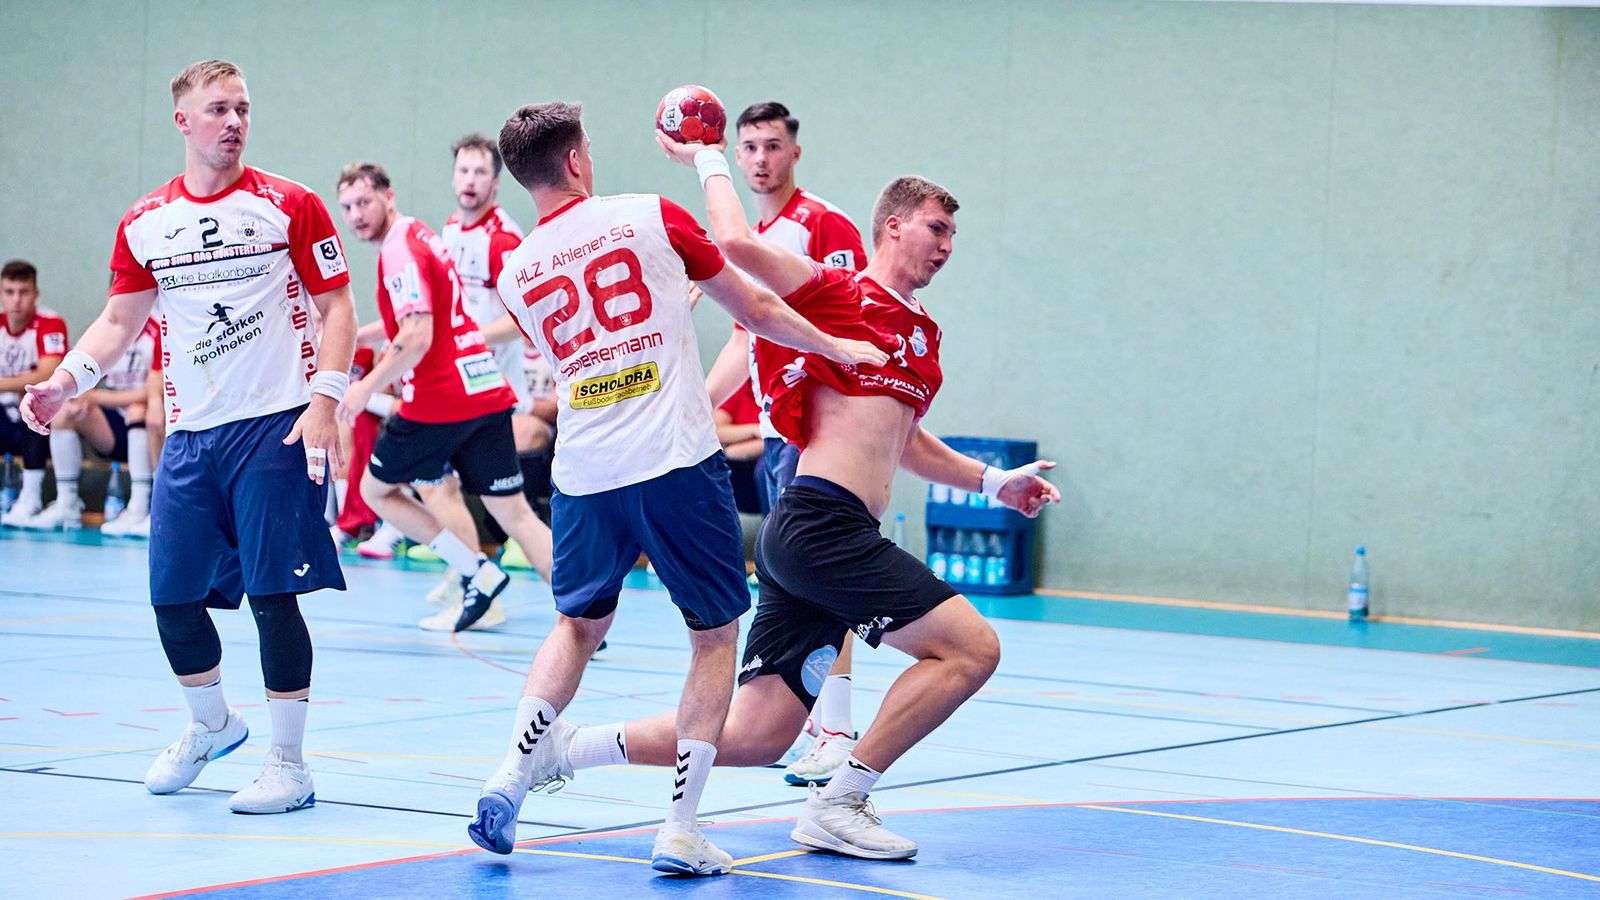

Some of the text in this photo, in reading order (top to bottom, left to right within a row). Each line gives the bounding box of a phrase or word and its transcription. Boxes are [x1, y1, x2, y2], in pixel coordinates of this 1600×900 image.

[199, 217, 224, 249] 2
[171, 253, 193, 265] SIND
[193, 251, 212, 262] DAS
[515, 224, 635, 288] HLZ Ahlener SG
[176, 273, 194, 284] die
[198, 263, 271, 281] balkonbauer
[522, 247, 653, 361] 28
[193, 327, 262, 365] Apotheken
[579, 369, 653, 396] SCHOLDRA
